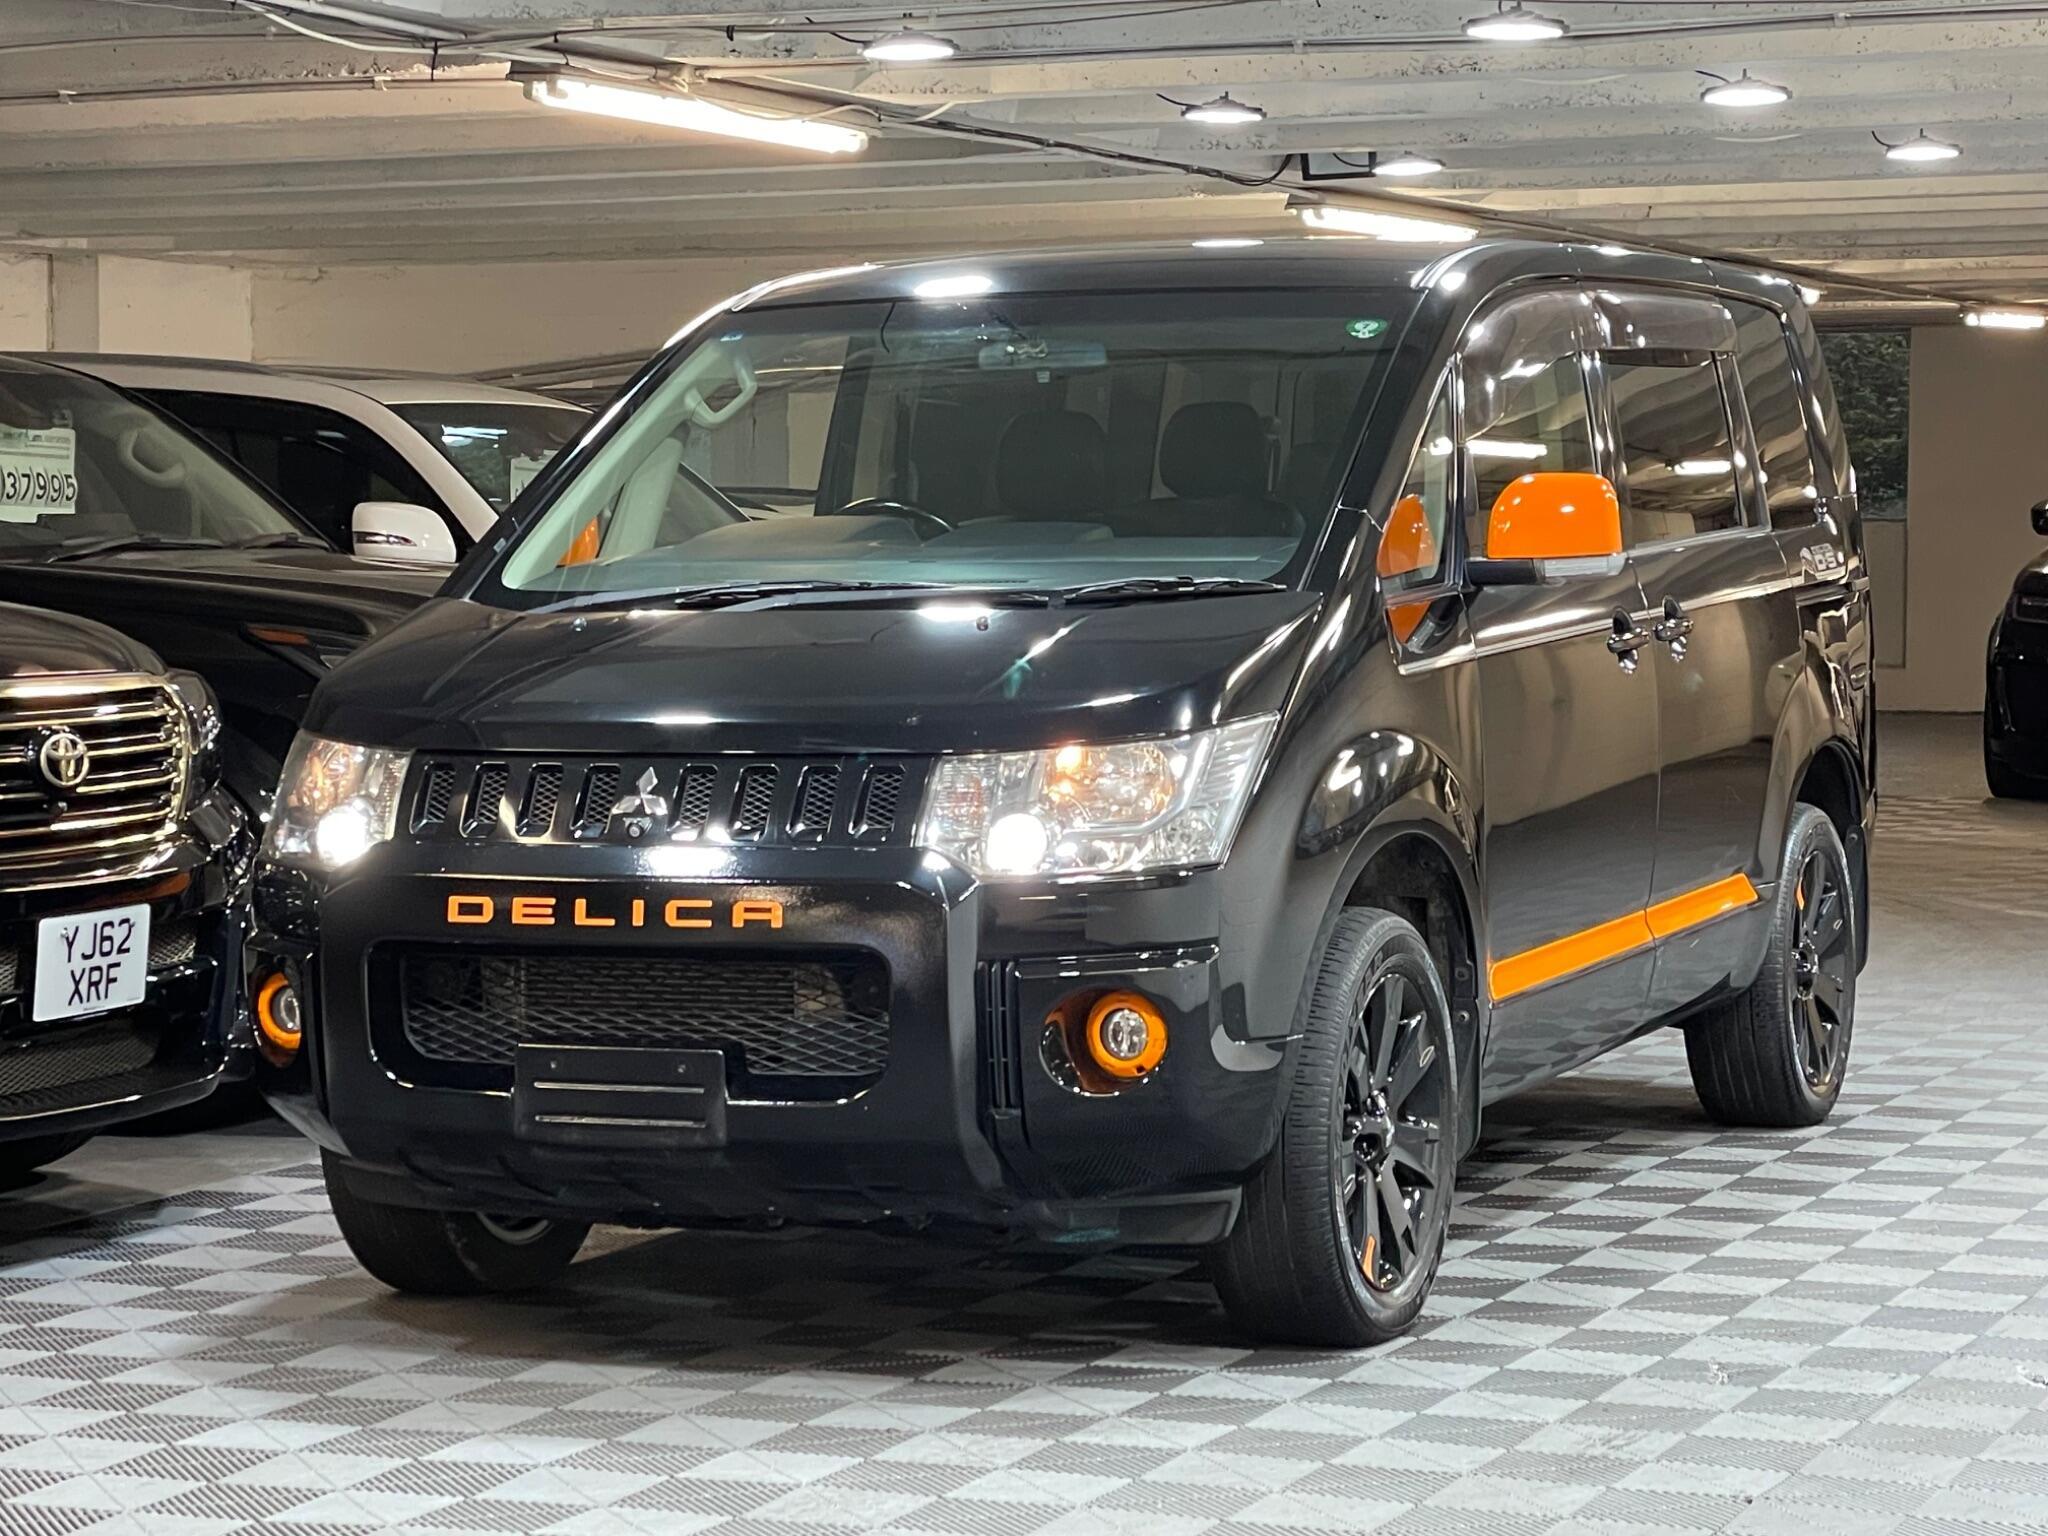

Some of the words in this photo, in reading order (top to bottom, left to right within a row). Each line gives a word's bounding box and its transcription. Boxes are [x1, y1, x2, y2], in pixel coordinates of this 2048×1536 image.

[5, 471, 77, 502] 37995
[447, 895, 784, 929] DELICA
[63, 917, 133, 963] YJ62
[67, 961, 122, 1006] XRF
